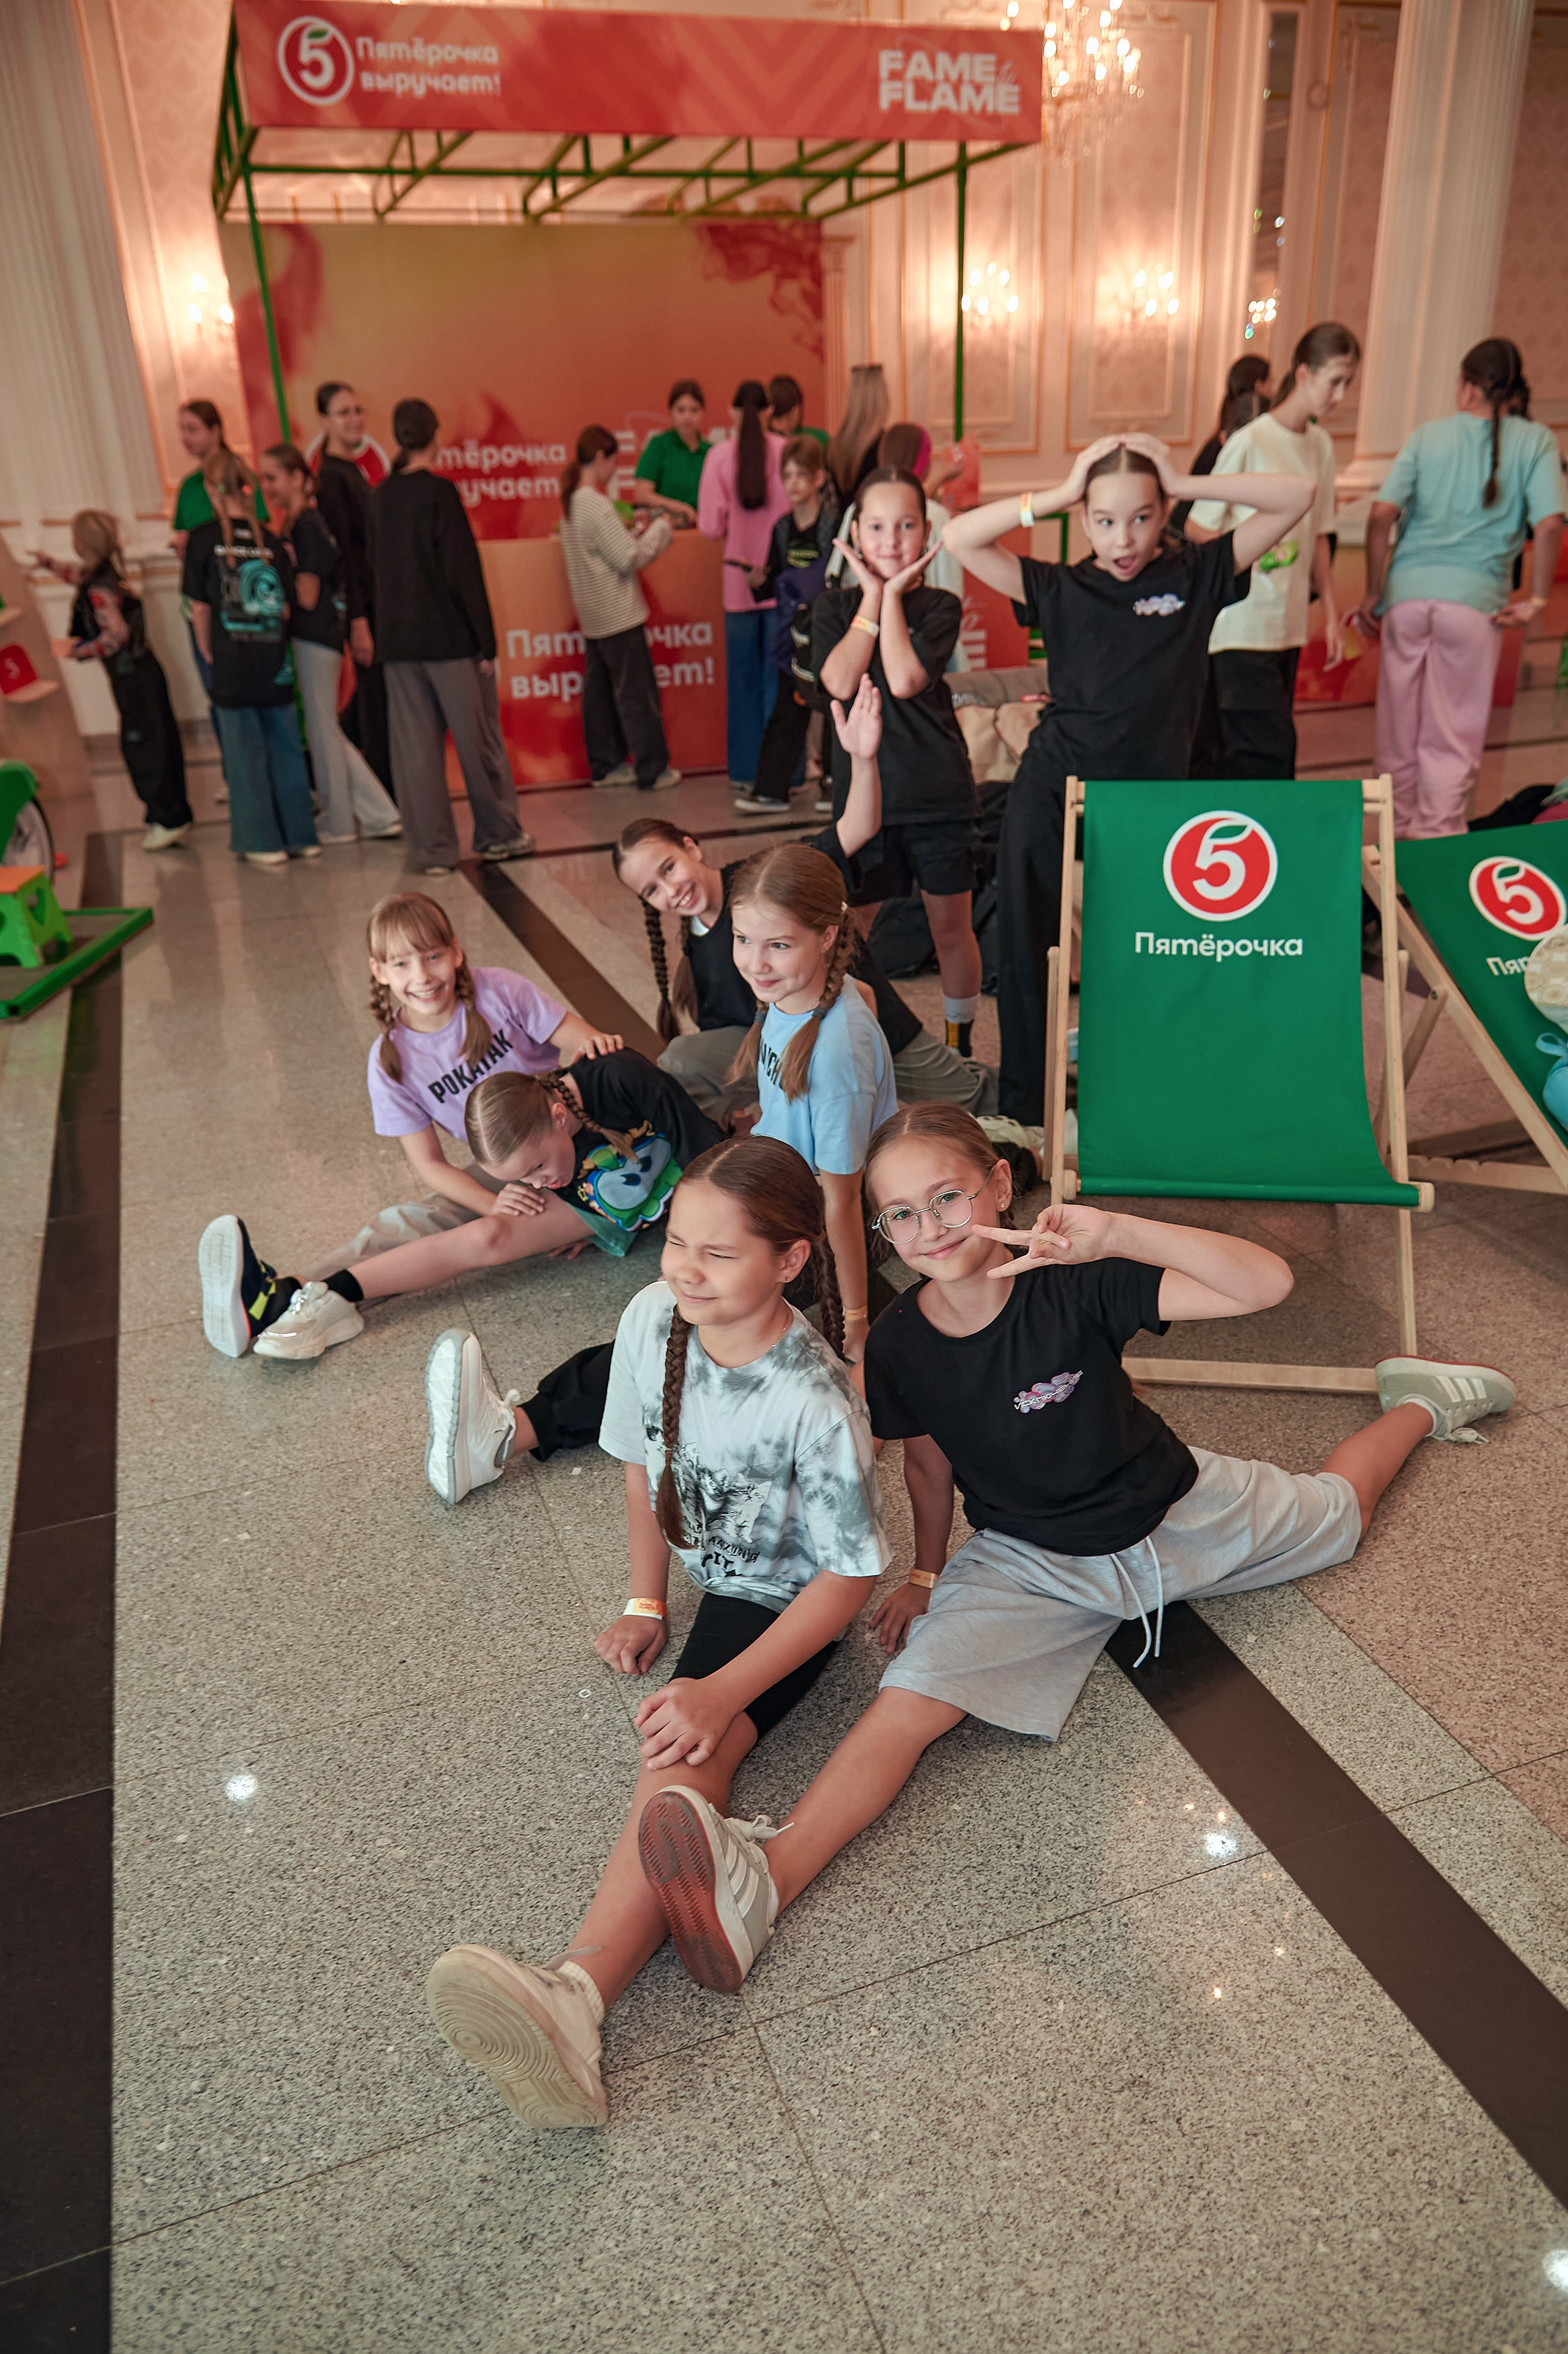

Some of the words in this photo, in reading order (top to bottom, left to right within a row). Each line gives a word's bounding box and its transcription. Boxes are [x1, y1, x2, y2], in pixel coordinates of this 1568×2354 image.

[356, 36, 498, 67] Пятёрочка
[879, 50, 996, 82] FAME
[359, 71, 502, 98] выручает!
[879, 80, 1020, 114] FLAME
[436, 439, 566, 474] тёрочка
[460, 476, 560, 508] учает
[1192, 819, 1253, 901] 5
[1491, 862, 1544, 925] 5
[1135, 932, 1303, 962] Пятёрочка
